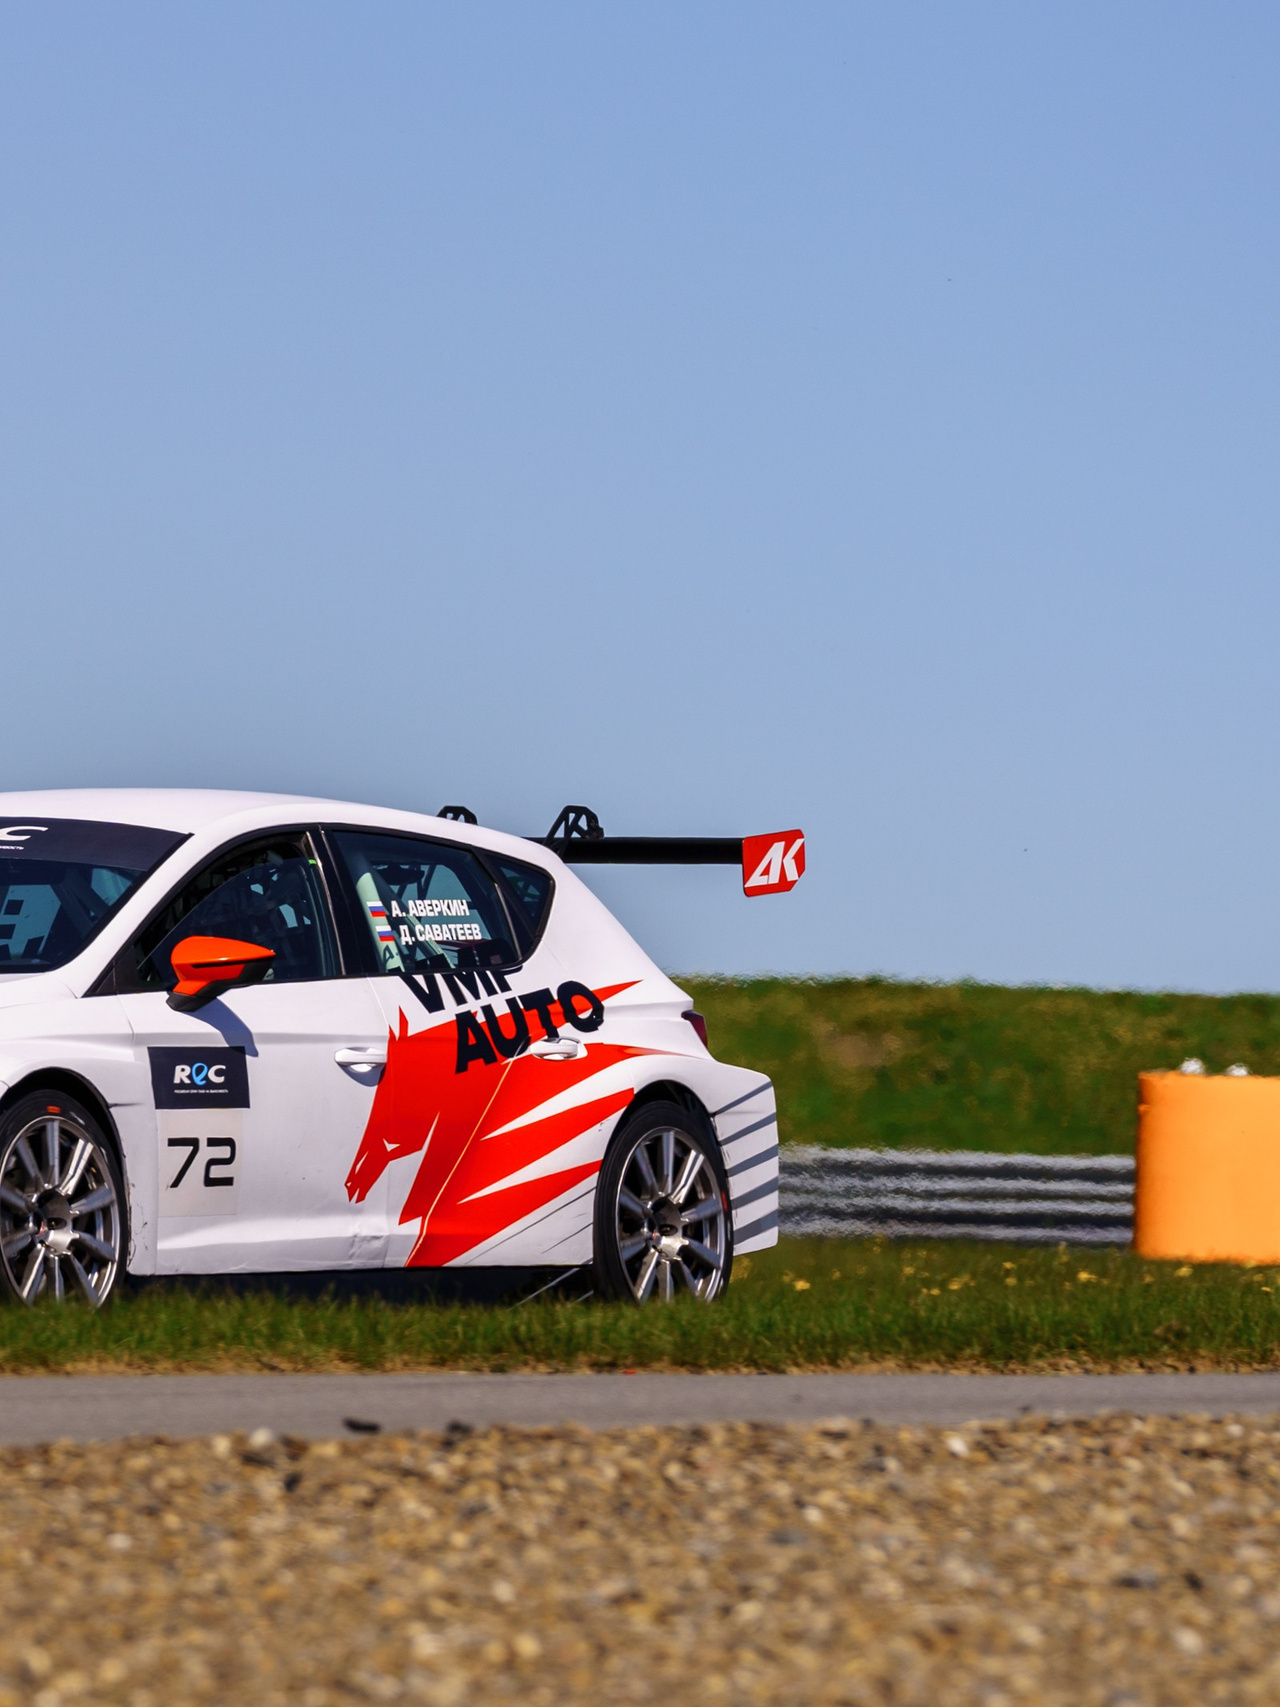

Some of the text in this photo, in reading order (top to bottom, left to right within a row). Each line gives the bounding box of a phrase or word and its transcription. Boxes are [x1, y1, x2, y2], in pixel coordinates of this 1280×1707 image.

[391, 899, 470, 917] А. АВЕРКИН
[399, 923, 482, 946] Д. САВАТЕЕВ
[455, 980, 605, 1075] AUTO
[167, 1137, 237, 1188] 72
